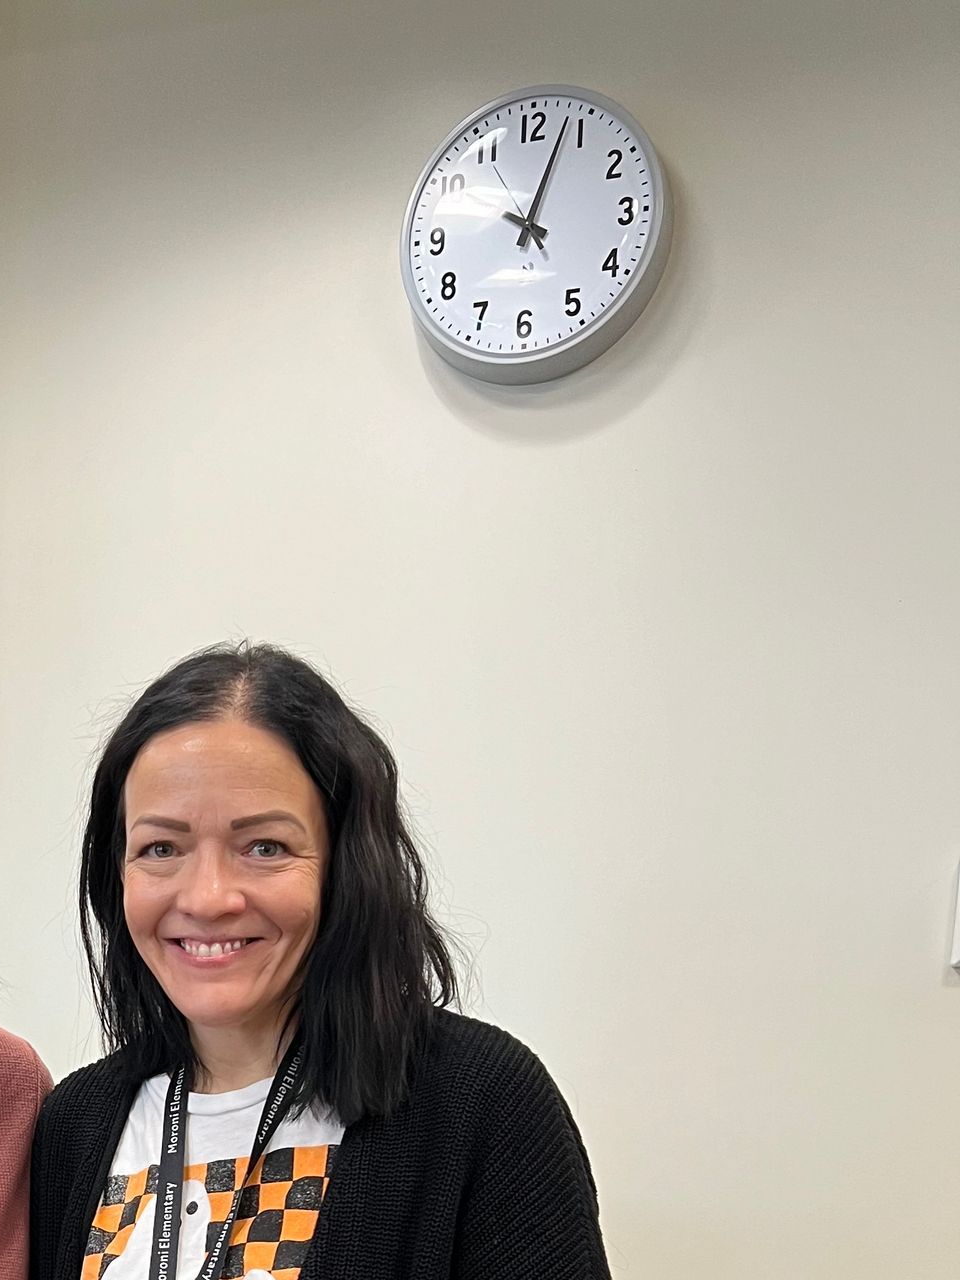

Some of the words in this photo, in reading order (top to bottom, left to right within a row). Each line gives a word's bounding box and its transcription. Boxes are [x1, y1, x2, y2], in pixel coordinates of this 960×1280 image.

[520, 112, 547, 144] 12
[576, 118, 585, 149] 1
[477, 134, 498, 165] 11
[605, 149, 623, 180] 2
[441, 173, 466, 197] 10
[617, 196, 635, 226] 3
[429, 227, 445, 256] 9
[601, 247, 620, 278] 4
[440, 271, 457, 301] 8
[473, 300, 489, 331] 7
[565, 287, 582, 317] 5
[516, 309, 533, 339] 6
[257, 1075, 295, 1144] Elementary
[167, 1112, 180, 1154] Moroni
[158, 1182, 178, 1249] Elementary
